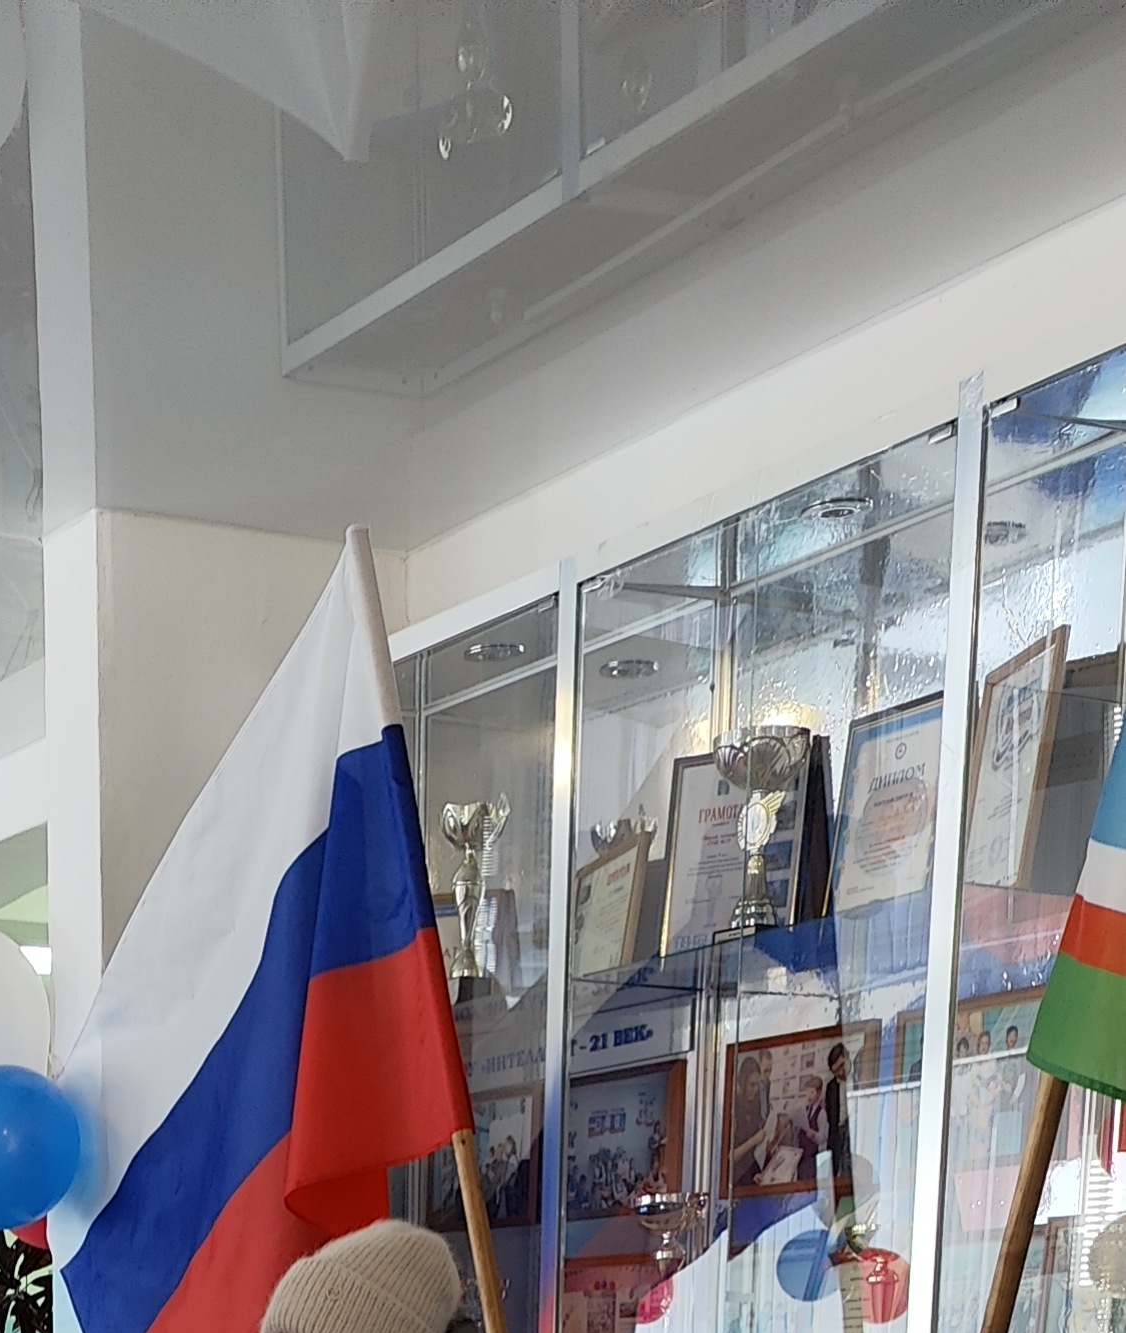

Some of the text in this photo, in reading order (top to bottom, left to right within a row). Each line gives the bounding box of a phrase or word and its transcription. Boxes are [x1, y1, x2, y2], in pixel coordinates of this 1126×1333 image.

[868, 762, 926, 794] ДИПЛОМ
[589, 1032, 609, 1052] 21
[612, 1023, 654, 1047] ВЕК»
